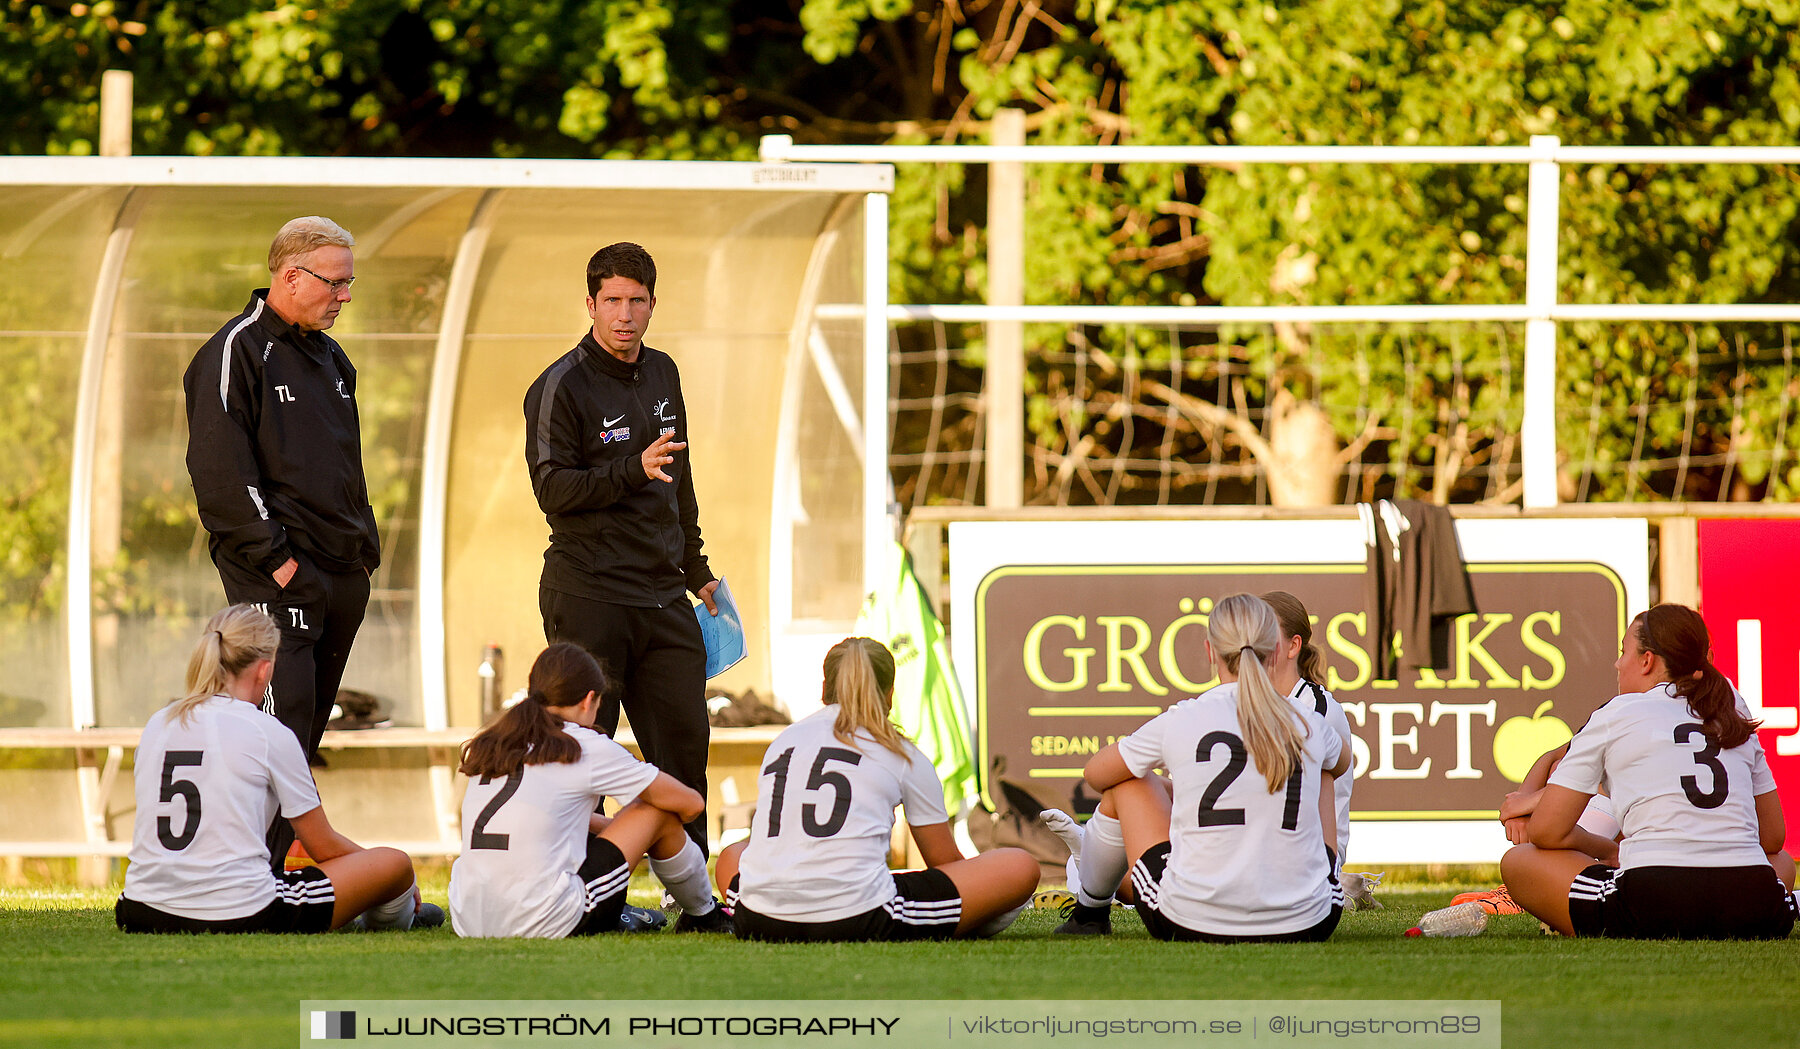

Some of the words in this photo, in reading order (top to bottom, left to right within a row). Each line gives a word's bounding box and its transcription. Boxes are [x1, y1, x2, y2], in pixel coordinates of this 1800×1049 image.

[275, 385, 296, 403] TL
[288, 607, 309, 630] TL
[1023, 597, 1566, 695] GRÖSKS
[1031, 735, 1099, 756] SEDAN
[1196, 730, 1302, 831] 21
[1674, 723, 1729, 809] 3
[157, 750, 204, 851] 5
[470, 762, 524, 851] 2
[763, 746, 862, 838] 15
